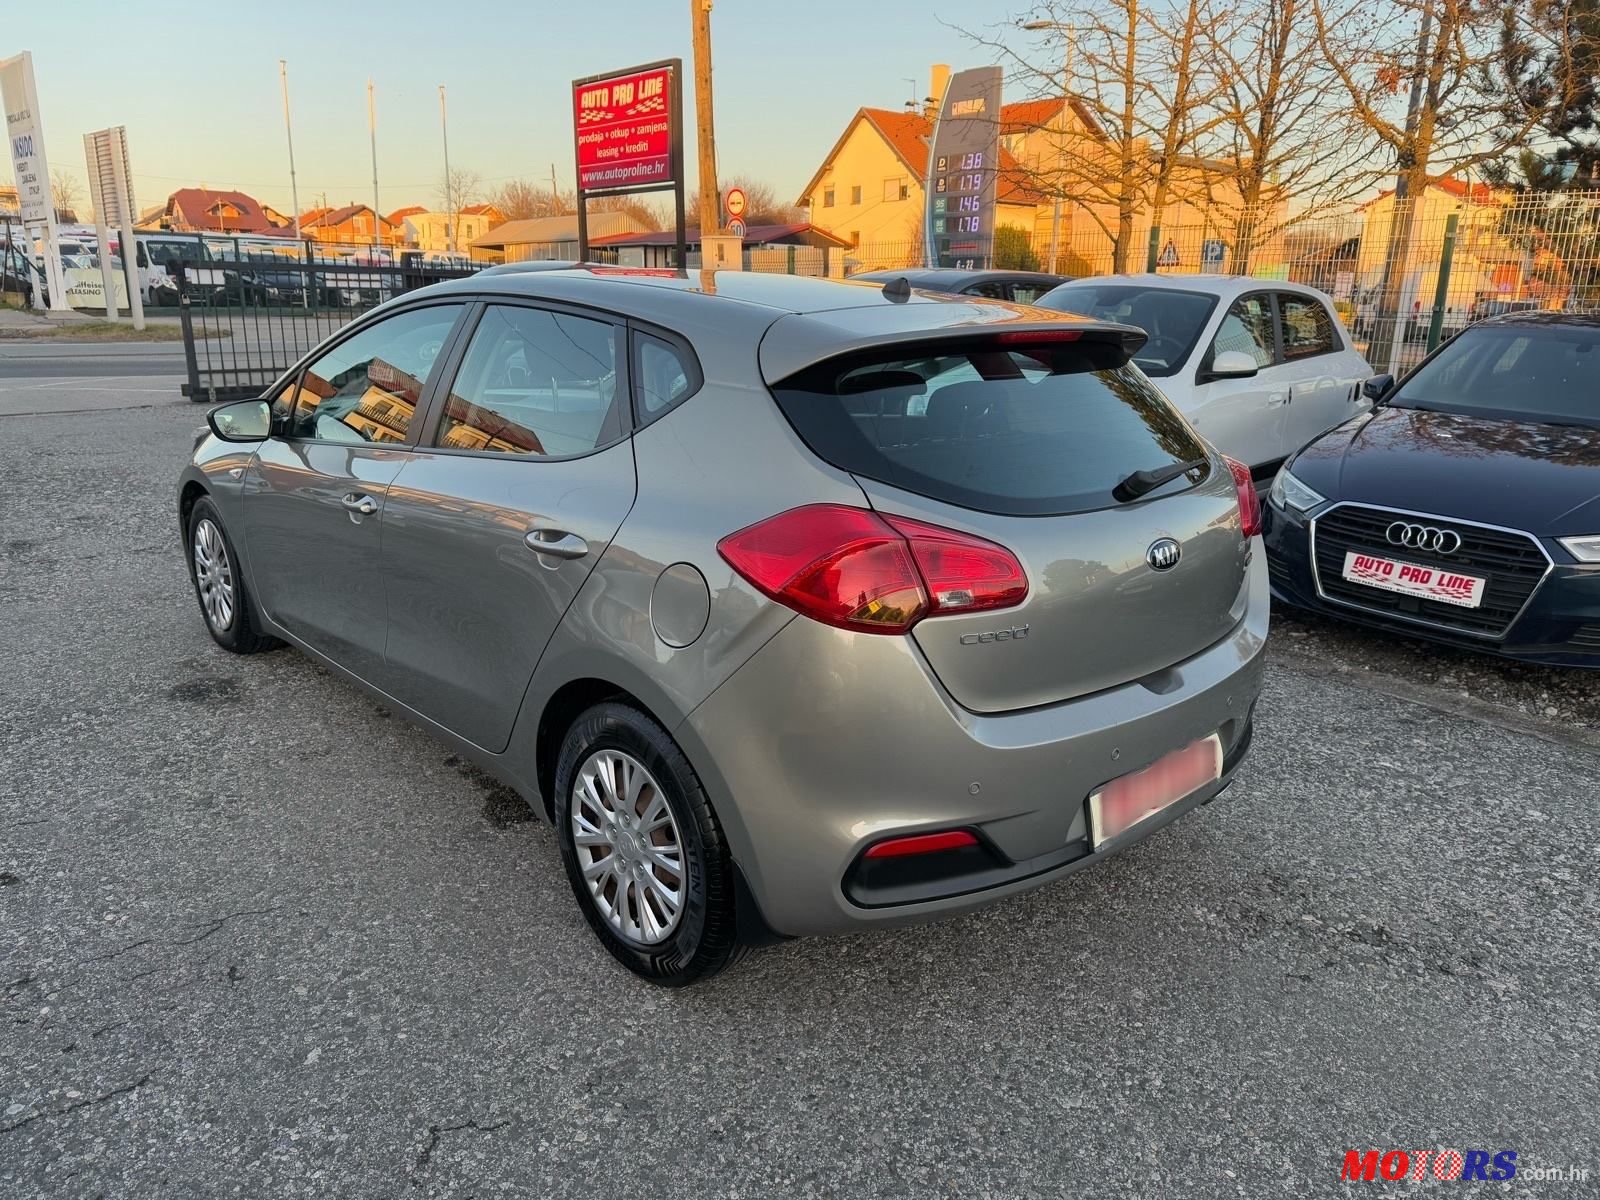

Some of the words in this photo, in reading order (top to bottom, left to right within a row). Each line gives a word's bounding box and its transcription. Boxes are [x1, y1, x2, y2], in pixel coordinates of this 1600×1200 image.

[581, 88, 609, 109] AUTO
[612, 83, 634, 107] PRO
[638, 76, 664, 100] LINE
[578, 131, 604, 146] prodaja
[610, 127, 630, 140] otkup
[636, 121, 668, 136] zamjena
[596, 146, 619, 159] leasing
[625, 140, 649, 153] krediti
[961, 152, 983, 170] 1.38
[581, 161, 665, 182] www.autoproline.hr
[960, 173, 981, 191] 1.79
[960, 195, 980, 212] 1.46
[958, 216, 980, 232] 1.78
[1153, 544, 1179, 567] KIA
[1354, 556, 1395, 576] AUTO
[1398, 565, 1433, 585] PRO
[1437, 574, 1476, 591] LINE
